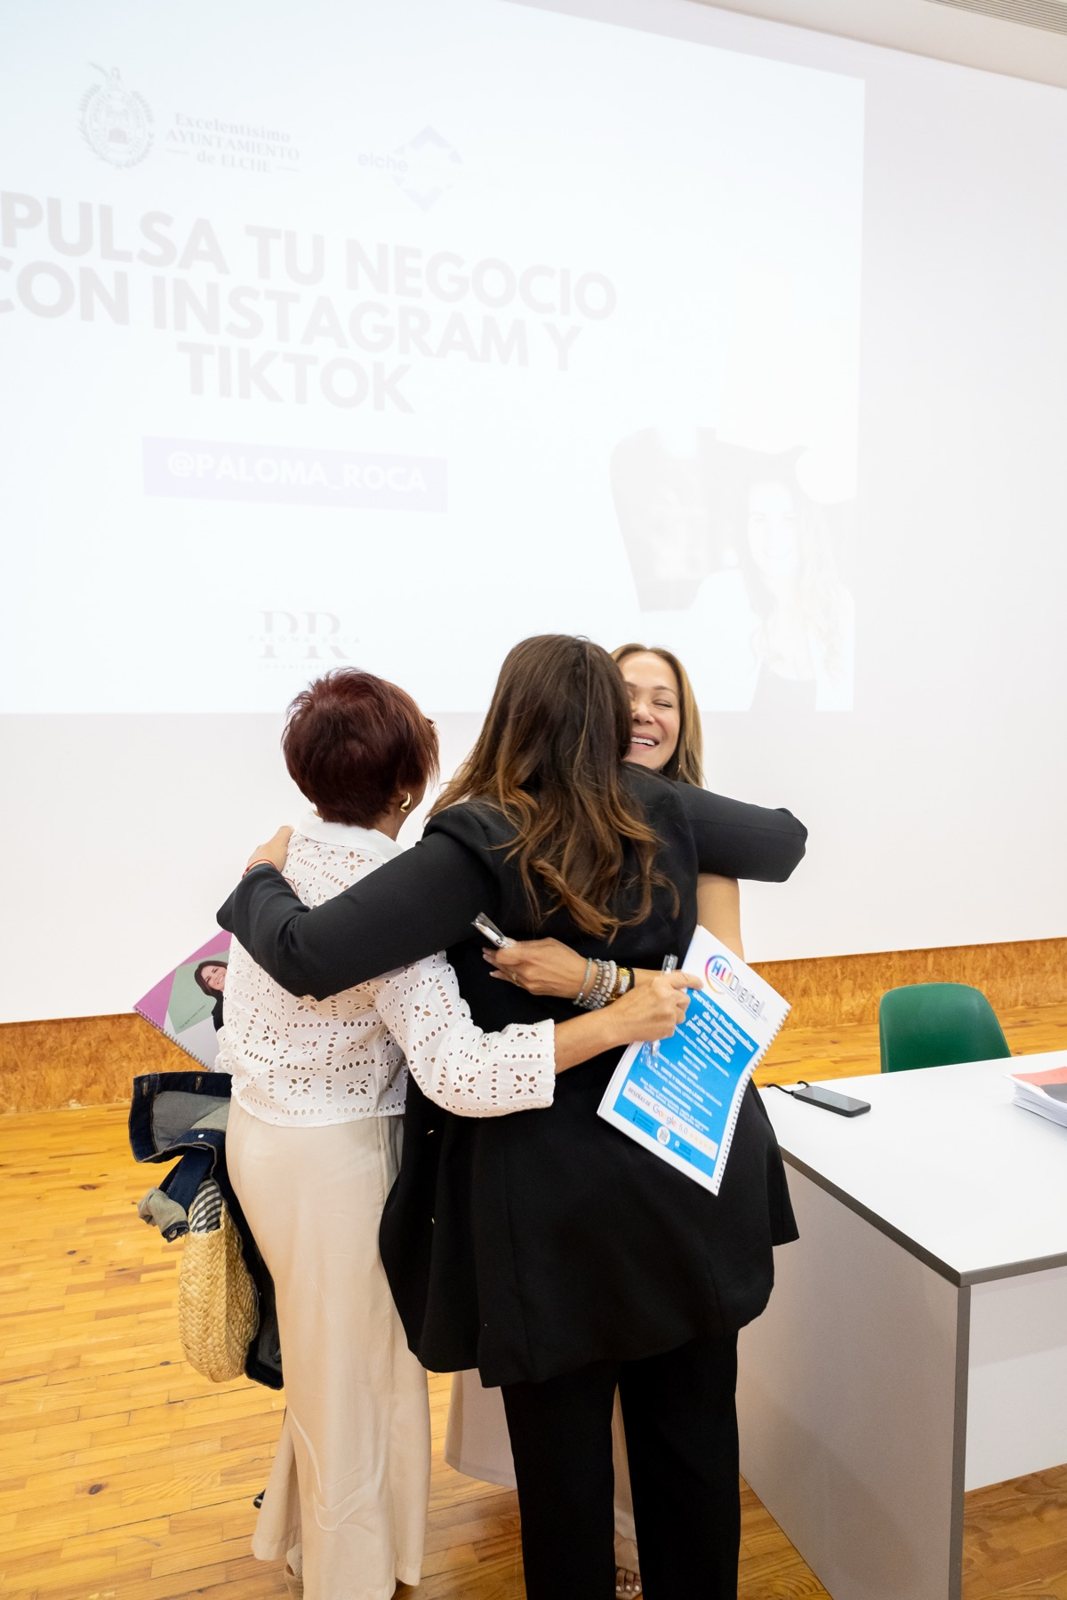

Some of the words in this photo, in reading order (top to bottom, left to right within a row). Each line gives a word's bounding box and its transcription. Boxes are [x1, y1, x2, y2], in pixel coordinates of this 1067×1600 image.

[165, 128, 301, 161] AYUNTAMIENTO
[196, 149, 216, 164] de
[220, 154, 272, 174] ELCHE
[356, 150, 409, 173] elche
[0, 190, 231, 275] PULSA
[244, 223, 325, 287] TU
[345, 238, 618, 321] NEGOCIO
[152, 275, 530, 368] INSTAGRAM
[541, 321, 583, 371] Y
[175, 341, 416, 415] TIKTOK
[167, 450, 428, 493] @PALOMA_ROCA
